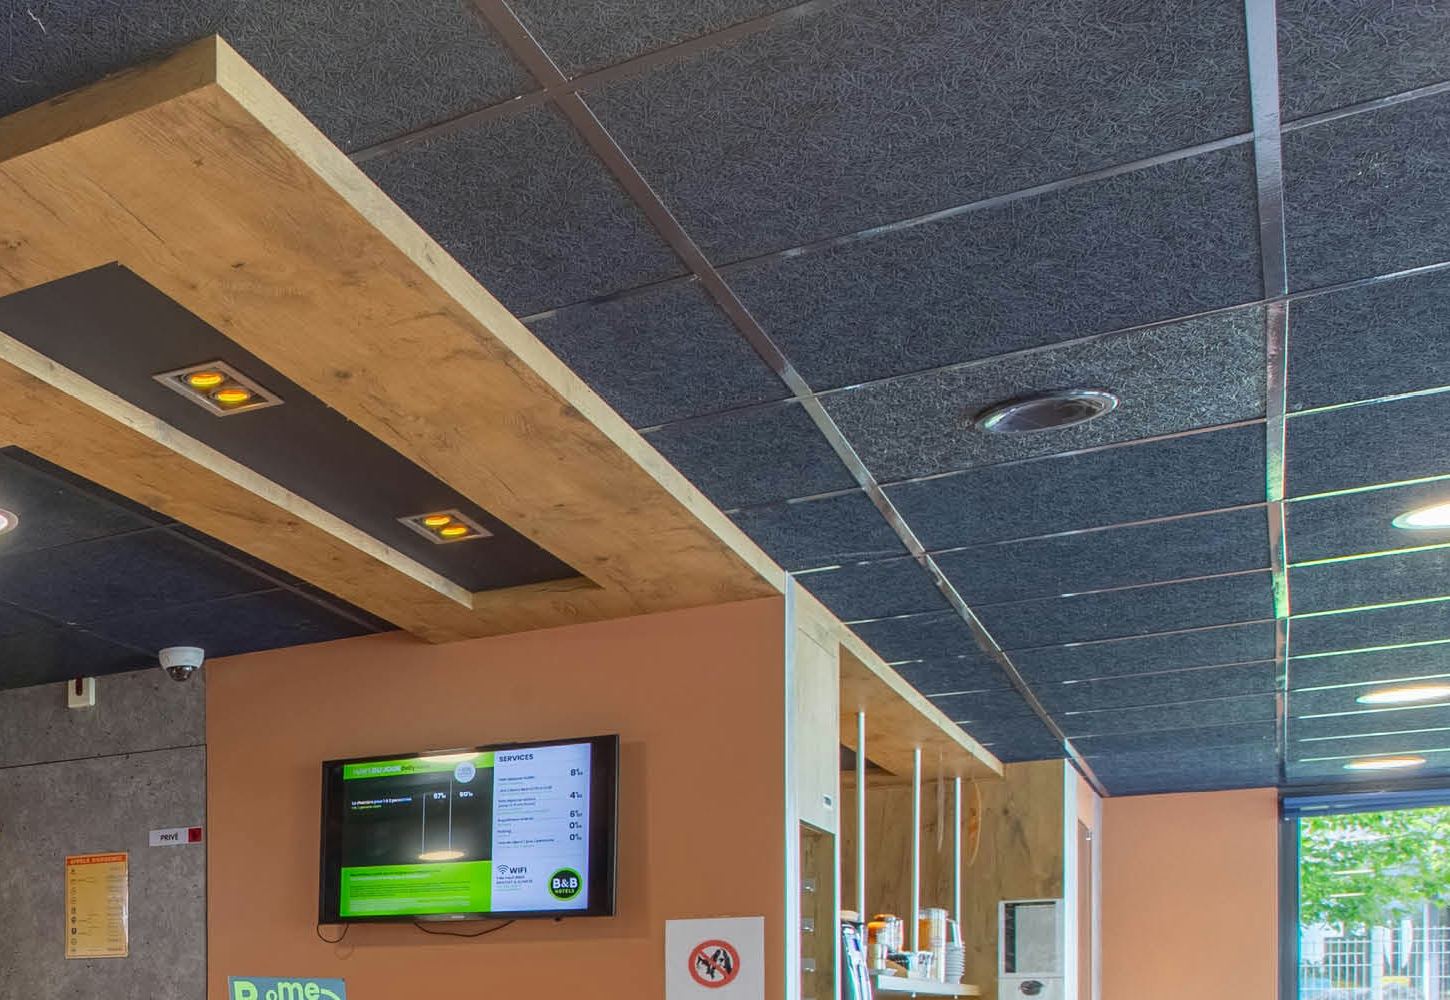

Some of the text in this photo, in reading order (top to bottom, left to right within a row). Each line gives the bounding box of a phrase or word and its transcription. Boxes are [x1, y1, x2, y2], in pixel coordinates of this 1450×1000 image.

[499, 753, 534, 763] SERVICES
[510, 866, 527, 875] WIFI
[552, 877, 579, 889] B&B
